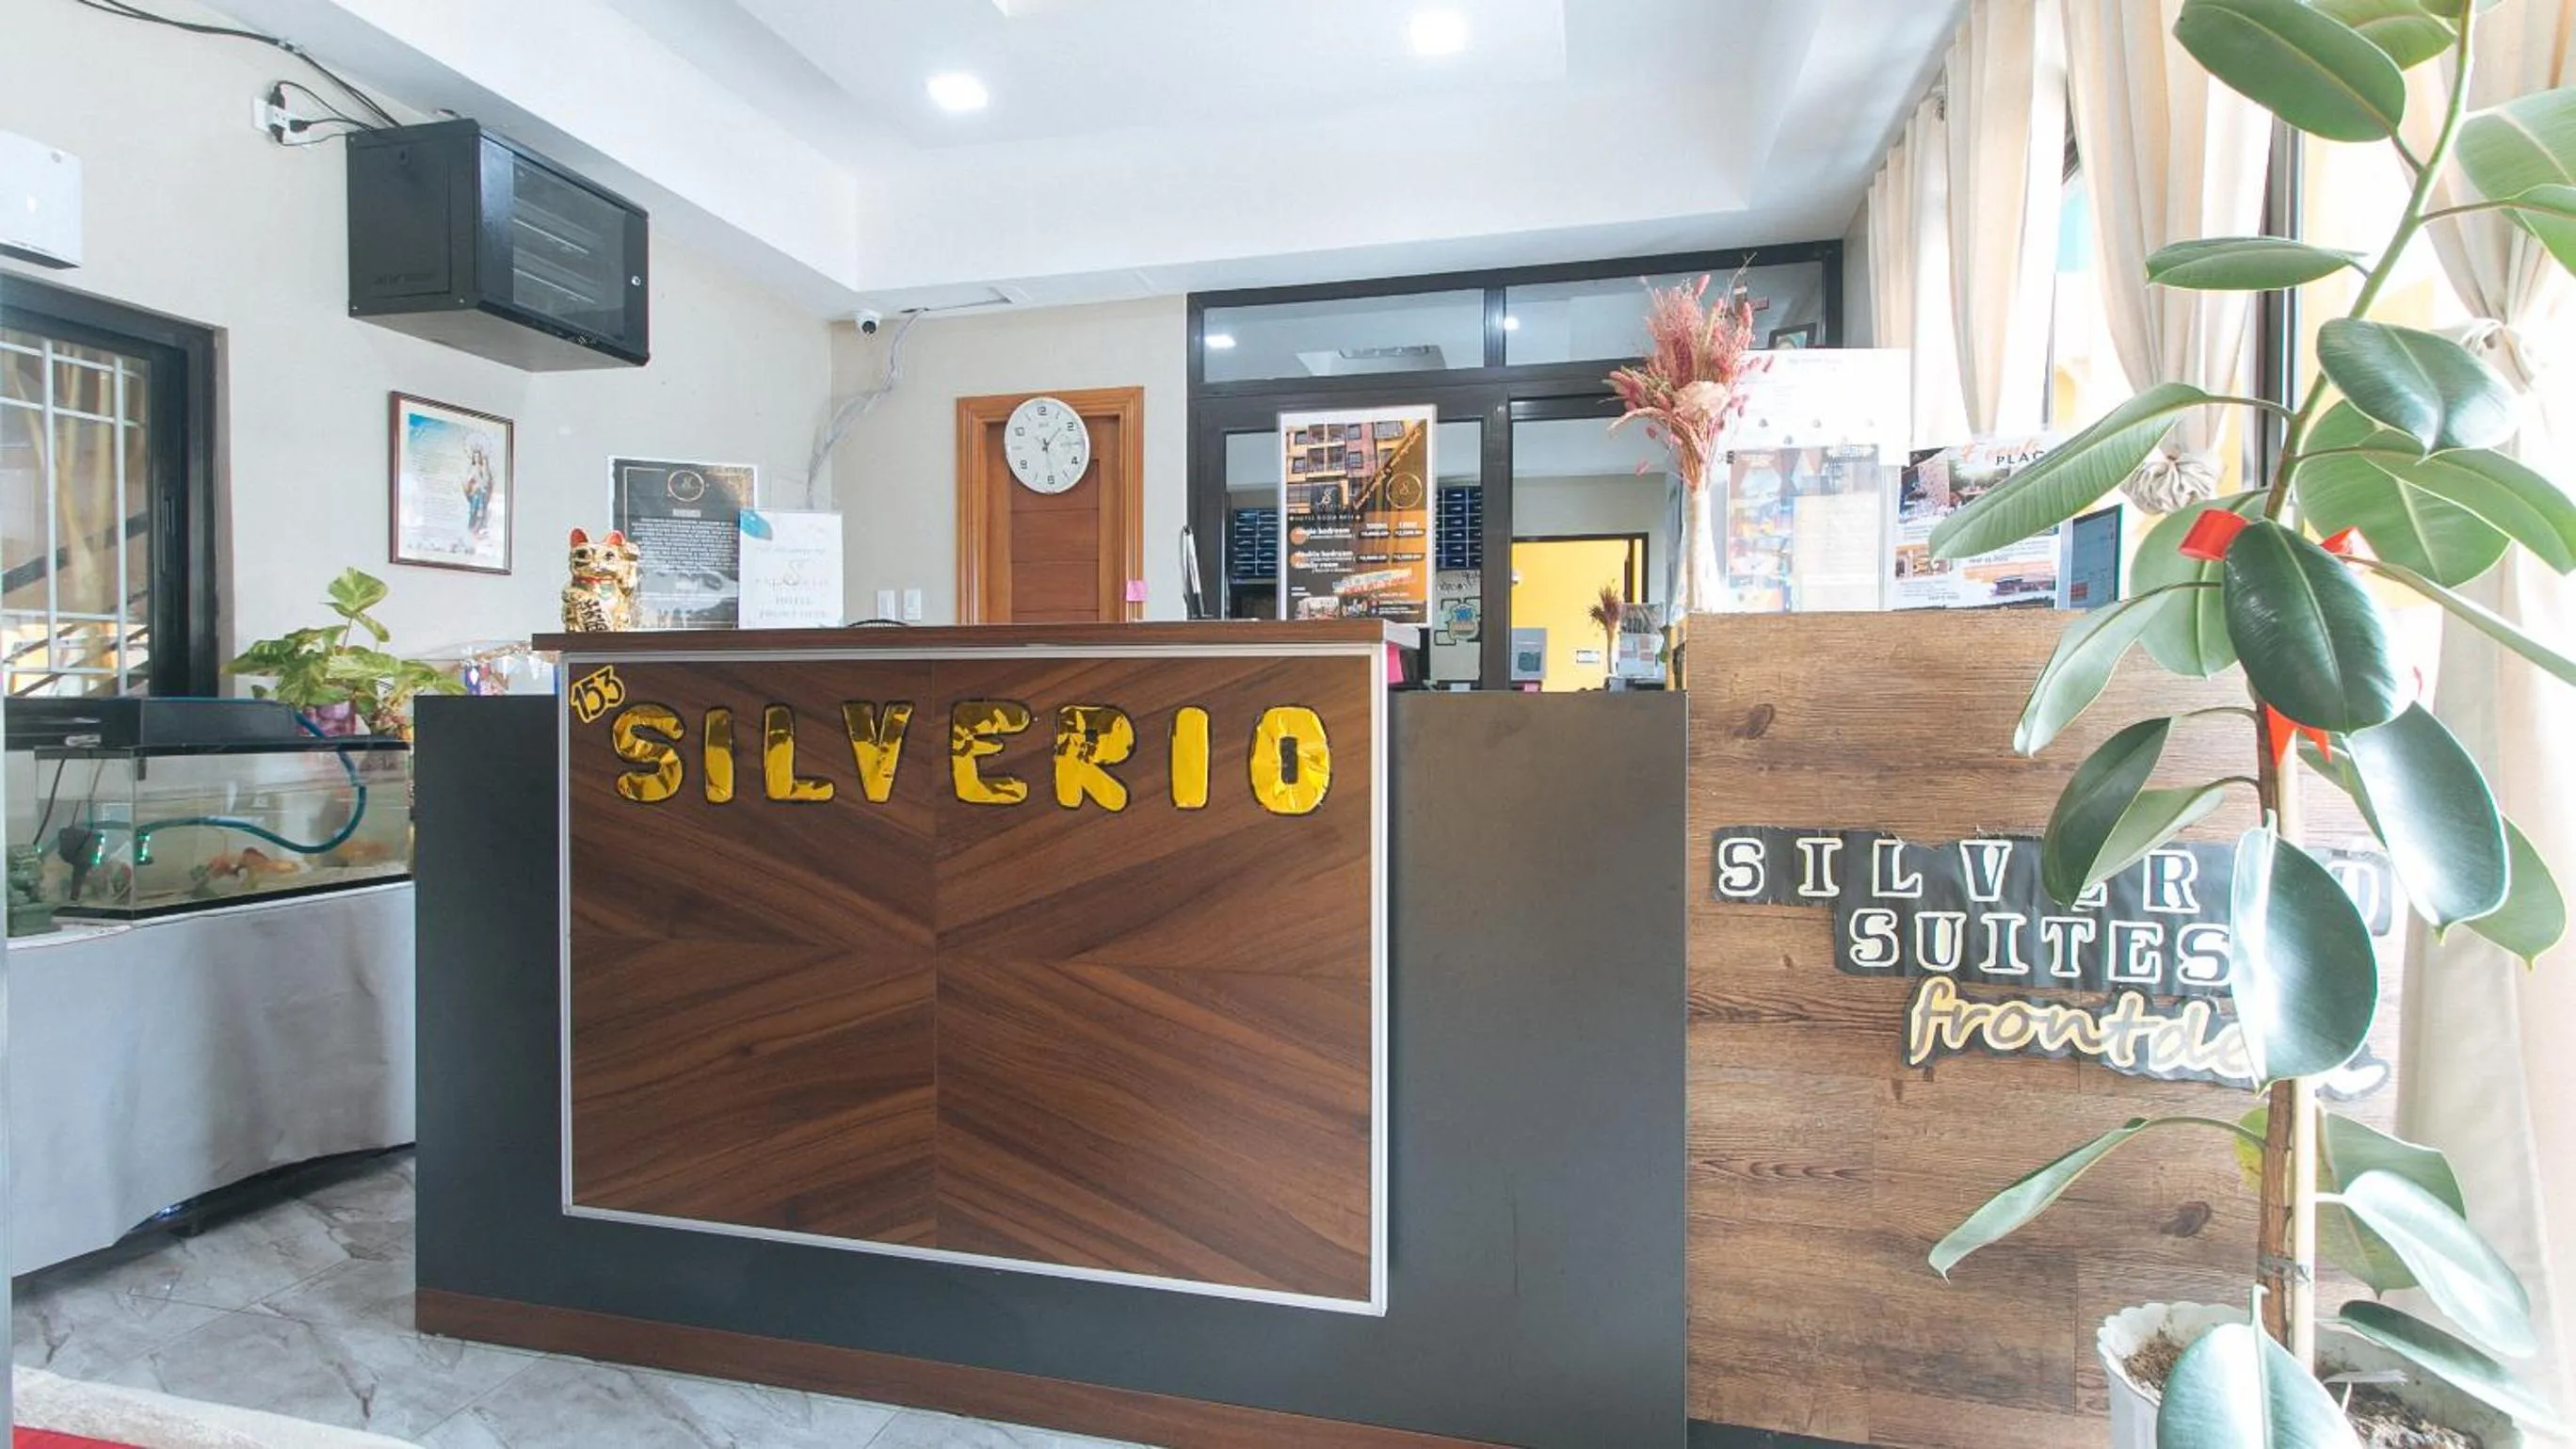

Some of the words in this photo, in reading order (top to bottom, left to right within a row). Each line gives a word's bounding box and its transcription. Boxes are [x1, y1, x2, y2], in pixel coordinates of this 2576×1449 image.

[1995, 450, 2046, 466] PLAC
[571, 666, 625, 723] 153
[611, 700, 1332, 816] SILVERIO
[1717, 837, 2380, 926] SILVRO
[1848, 907, 2230, 986] SUITES
[1908, 975, 2388, 1095] frontde
